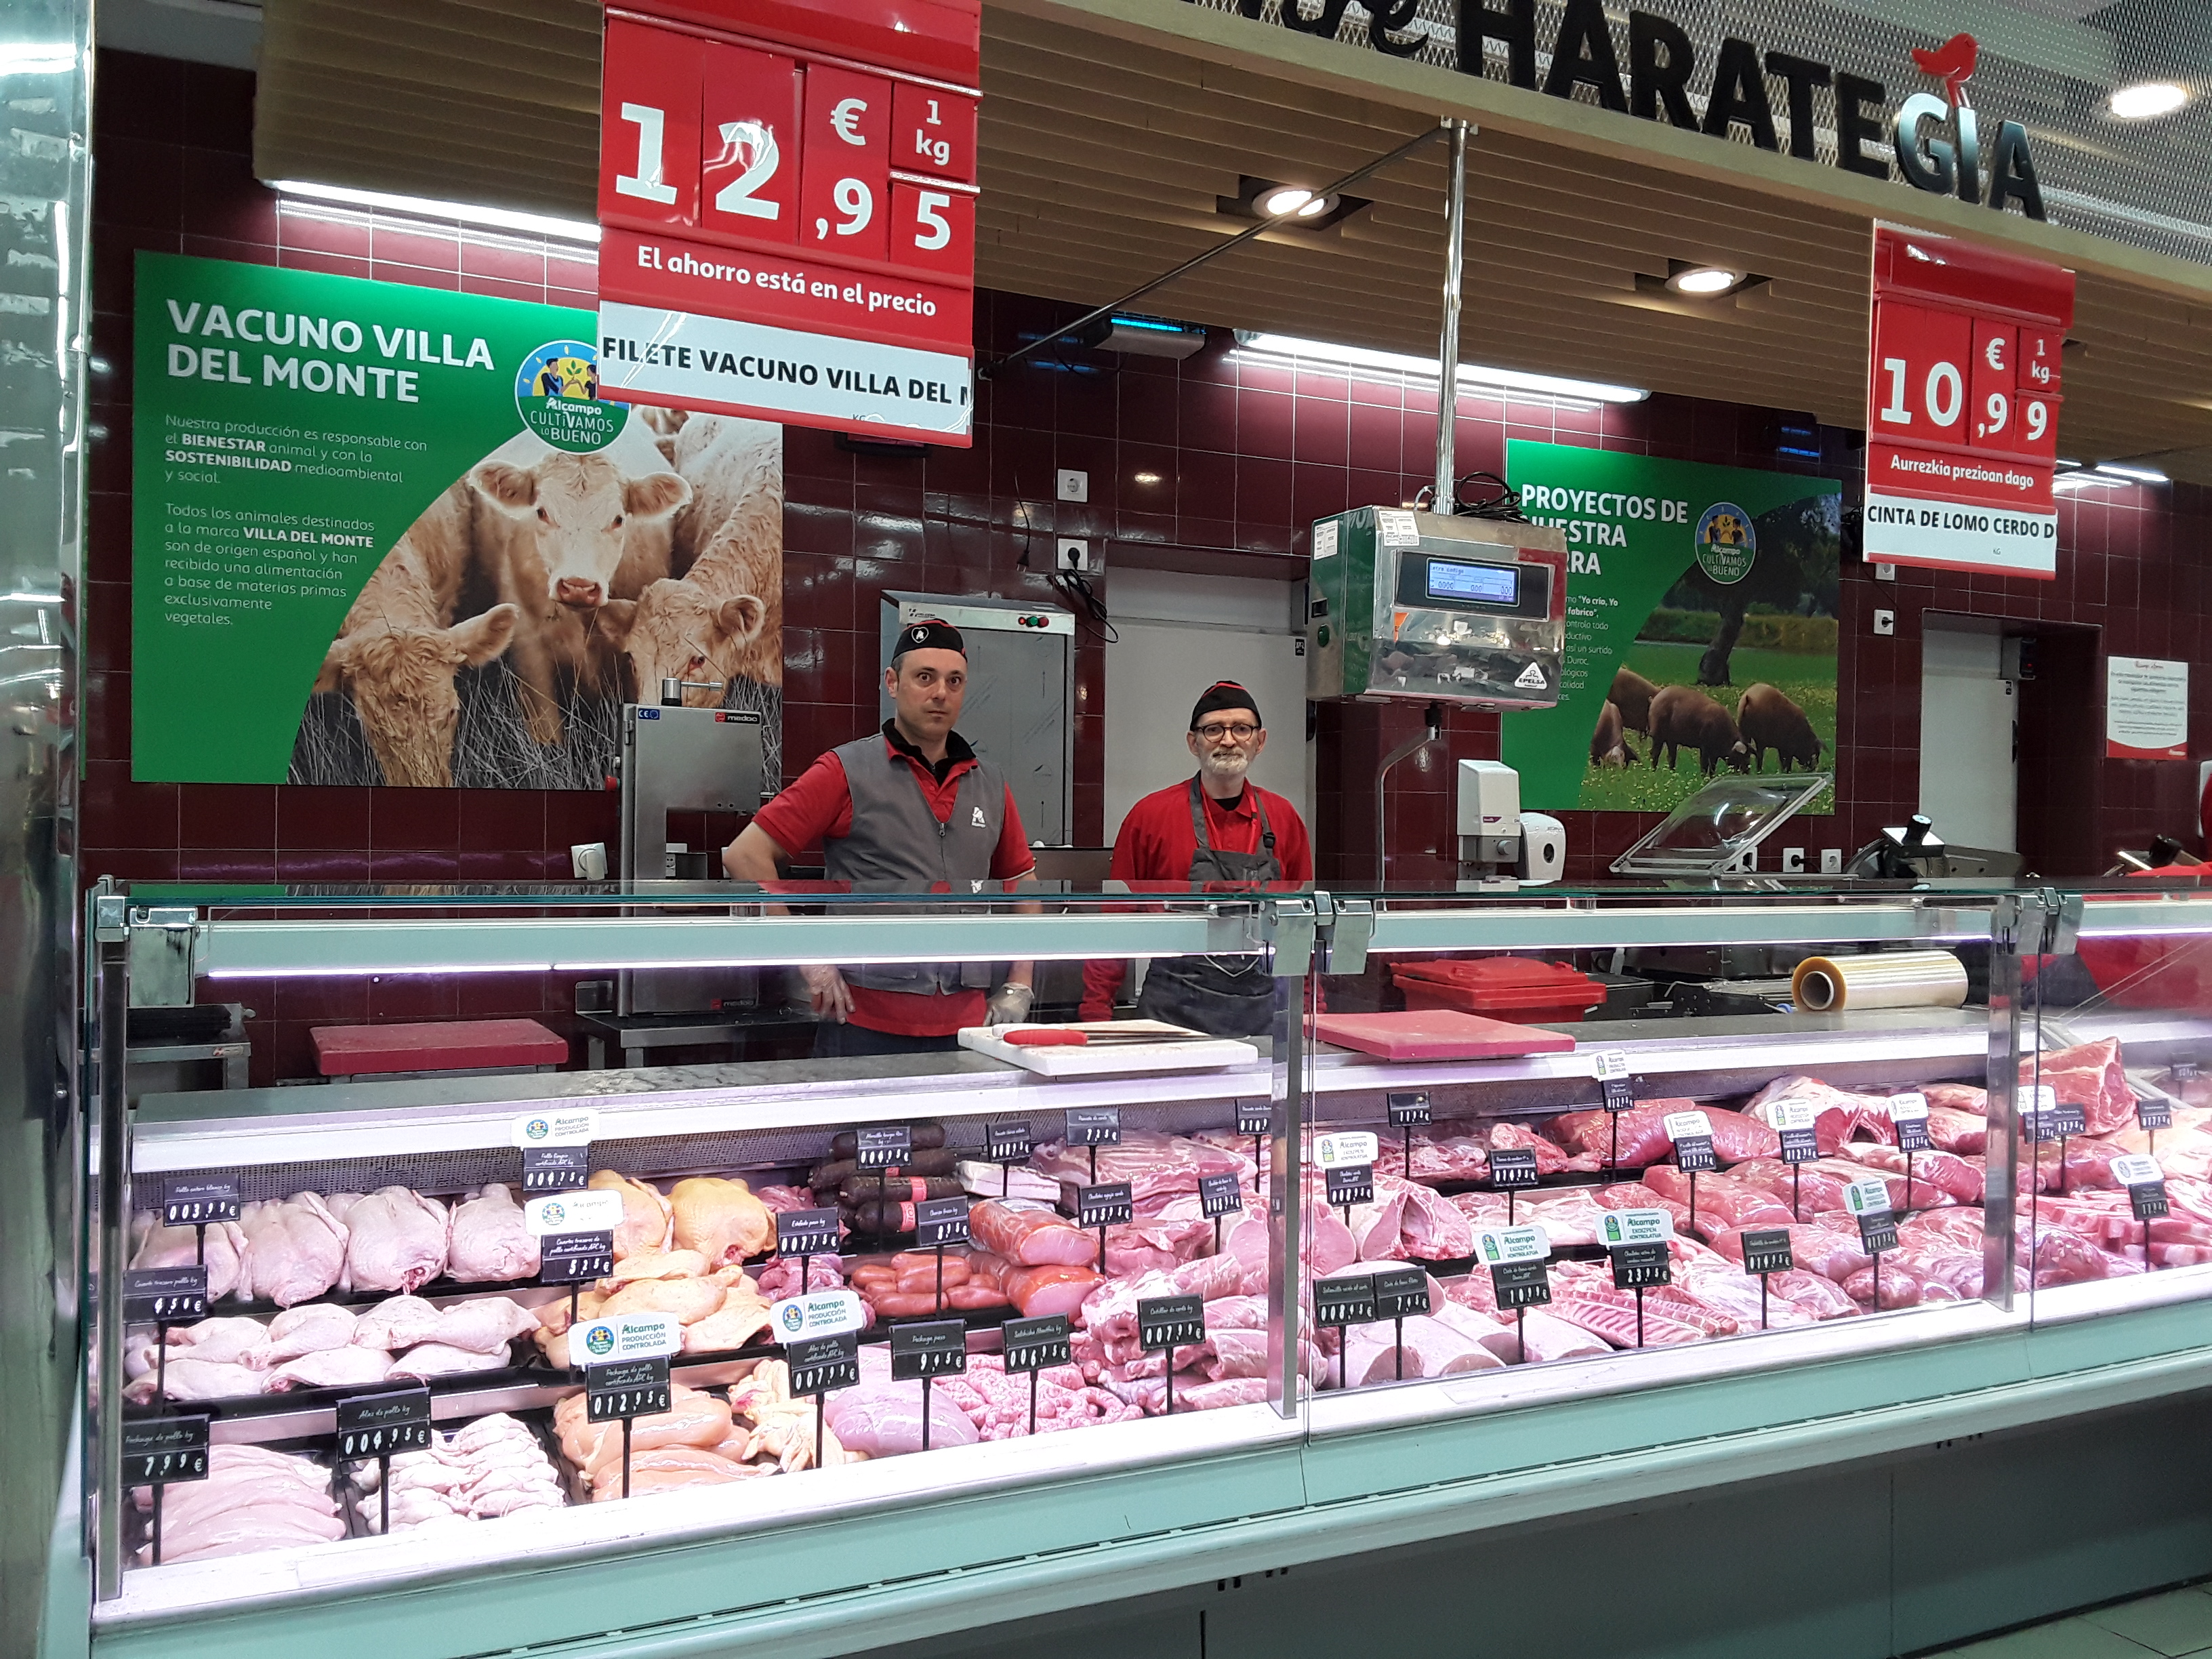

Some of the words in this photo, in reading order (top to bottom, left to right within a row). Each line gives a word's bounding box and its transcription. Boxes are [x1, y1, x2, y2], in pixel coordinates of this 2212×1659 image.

[1456, 0, 2049, 222] HARATEGIA
[916, 129, 949, 166] kg
[638, 245, 663, 270] El
[668, 253, 751, 285] ahorro
[756, 270, 806, 295] está
[811, 283, 838, 300] en
[843, 283, 865, 305] el
[869, 291, 937, 317] precio
[165, 299, 364, 354] VACUNO
[373, 323, 495, 371] VILLA
[167, 344, 251, 386] DEL
[262, 354, 420, 404] MONTE
[602, 337, 691, 370] FILETE
[699, 349, 819, 386] VACUNO
[827, 368, 900, 398] VILLA
[909, 379, 952, 405] DEL
[2032, 361, 2050, 382] kg
[546, 396, 602, 416] Alcampo
[165, 414, 220, 430] Nuestra
[225, 422, 300, 438] producción
[304, 429, 319, 441] es
[323, 431, 401, 449] responsable
[404, 440, 428, 451] con
[551, 427, 602, 445] BUENO
[165, 434, 178, 445] el
[182, 433, 266, 453] BIENESTAR
[269, 443, 317, 457] animal
[321, 449, 329, 461] y
[332, 450, 356, 462] con
[360, 450, 372, 462] la
[165, 449, 292, 473] SOSTENIBILIDAD
[295, 462, 403, 484] medioambiental
[165, 470, 173, 483] y
[178, 470, 221, 484] social.
[1891, 455, 1951, 477] Aurrezkia
[1952, 467, 2004, 485] prezioan
[2005, 470, 2034, 490] dago
[1522, 484, 1656, 520] PROYECTOS
[1660, 499, 1688, 524] DE
[165, 502, 207, 518] Todos
[211, 507, 231, 520] los
[235, 510, 298, 525] animales
[302, 514, 375, 531] destinados
[1868, 506, 1916, 527] CINTA
[1921, 510, 1940, 528] DE
[1944, 512, 1989, 532] LOMO
[1993, 518, 2040, 537] CERDO
[165, 523, 173, 533] a
[178, 523, 191, 534] la
[196, 526, 239, 538] marca
[243, 527, 287, 541] VILLA
[290, 531, 318, 544] DEL
[321, 533, 374, 548] MONTE
[165, 541, 190, 552] son
[194, 541, 211, 554] de
[216, 544, 258, 558] origen
[263, 548, 316, 562] español
[320, 552, 328, 564] y
[332, 552, 358, 564] han
[165, 558, 220, 572] recibido
[224, 562, 250, 574] una
[255, 563, 343, 580] alimentación
[1713, 565, 1740, 576] BUENO
[164, 577, 173, 586] a
[178, 575, 210, 589] base
[215, 579, 232, 590] de
[237, 581, 297, 595] materias
[301, 586, 347, 598] primas
[164, 594, 272, 611] exclusivamente
[1609, 598, 1618, 607] Yo
[165, 612, 233, 627] vegetales.
[555, 1116, 589, 1126] Alcampo
[1628, 1218, 1660, 1227] Alcampo
[1504, 1235, 1535, 1244] Alcampo
[808, 1300, 845, 1312] Alcampo
[621, 1323, 665, 1335] Alcampo
[808, 1315, 847, 1328] CONTROLADA
[621, 1332, 666, 1343] PRODUCCIÓN
[622, 1339, 667, 1351] CONTROLADA
